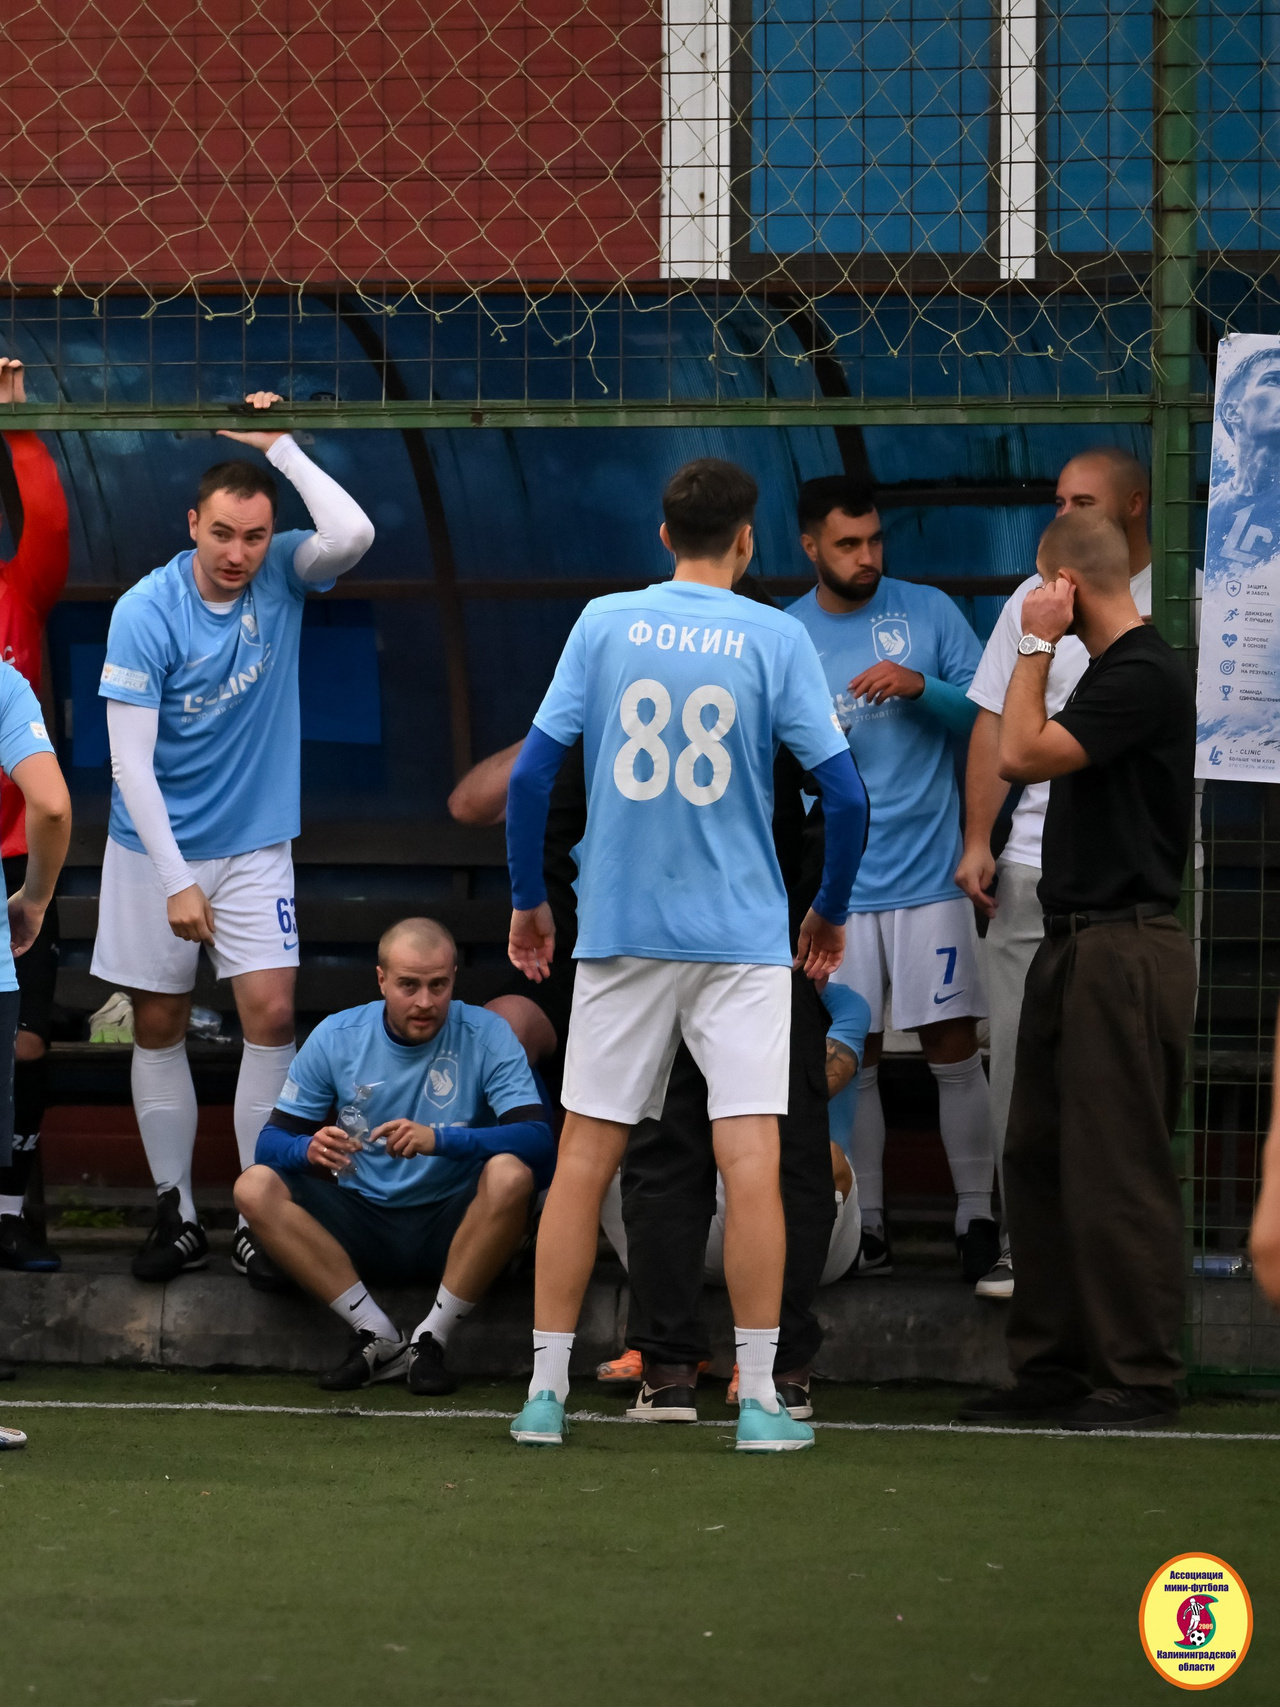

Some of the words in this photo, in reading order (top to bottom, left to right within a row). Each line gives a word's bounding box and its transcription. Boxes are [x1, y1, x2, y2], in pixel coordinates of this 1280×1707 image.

[628, 620, 746, 659] ФОКИН
[613, 678, 736, 807] 88
[1240, 748, 1261, 756] CLINIC
[936, 946, 958, 985] 7
